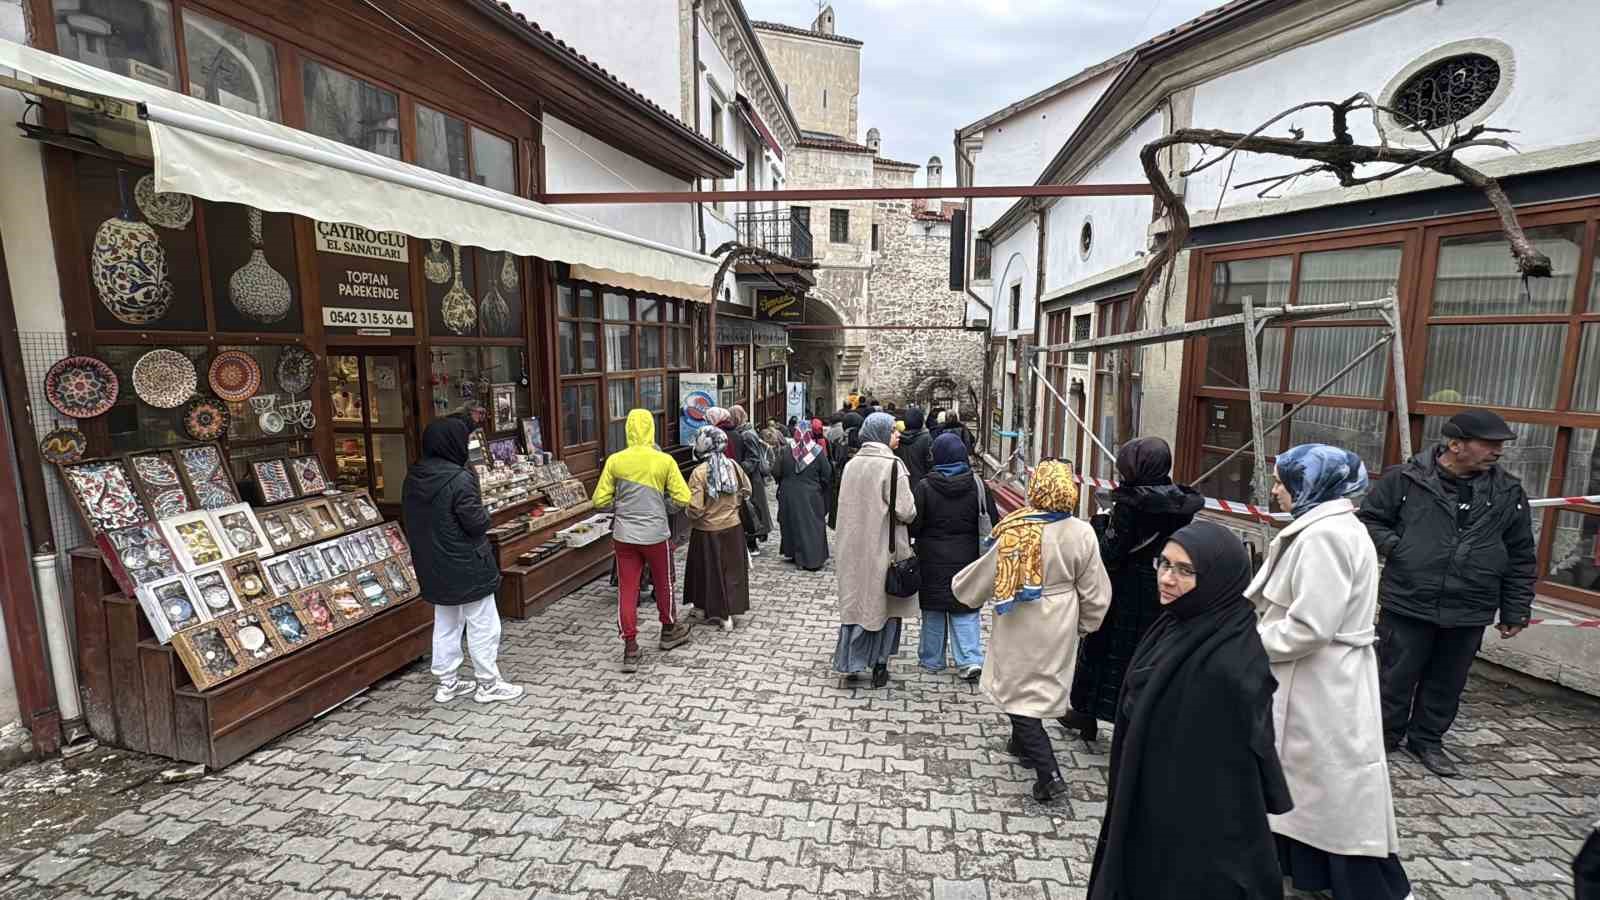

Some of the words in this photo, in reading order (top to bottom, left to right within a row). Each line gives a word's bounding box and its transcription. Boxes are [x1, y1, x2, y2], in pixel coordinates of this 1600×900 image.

[327, 240, 341, 251] EL
[343, 241, 401, 260] SANATLARI
[345, 270, 389, 287] TOPTAN
[338, 283, 400, 300] PAREKENDE
[330, 311, 357, 324] 0542
[360, 312, 379, 324] 315
[382, 313, 394, 325] 36
[396, 314, 408, 325] 64
